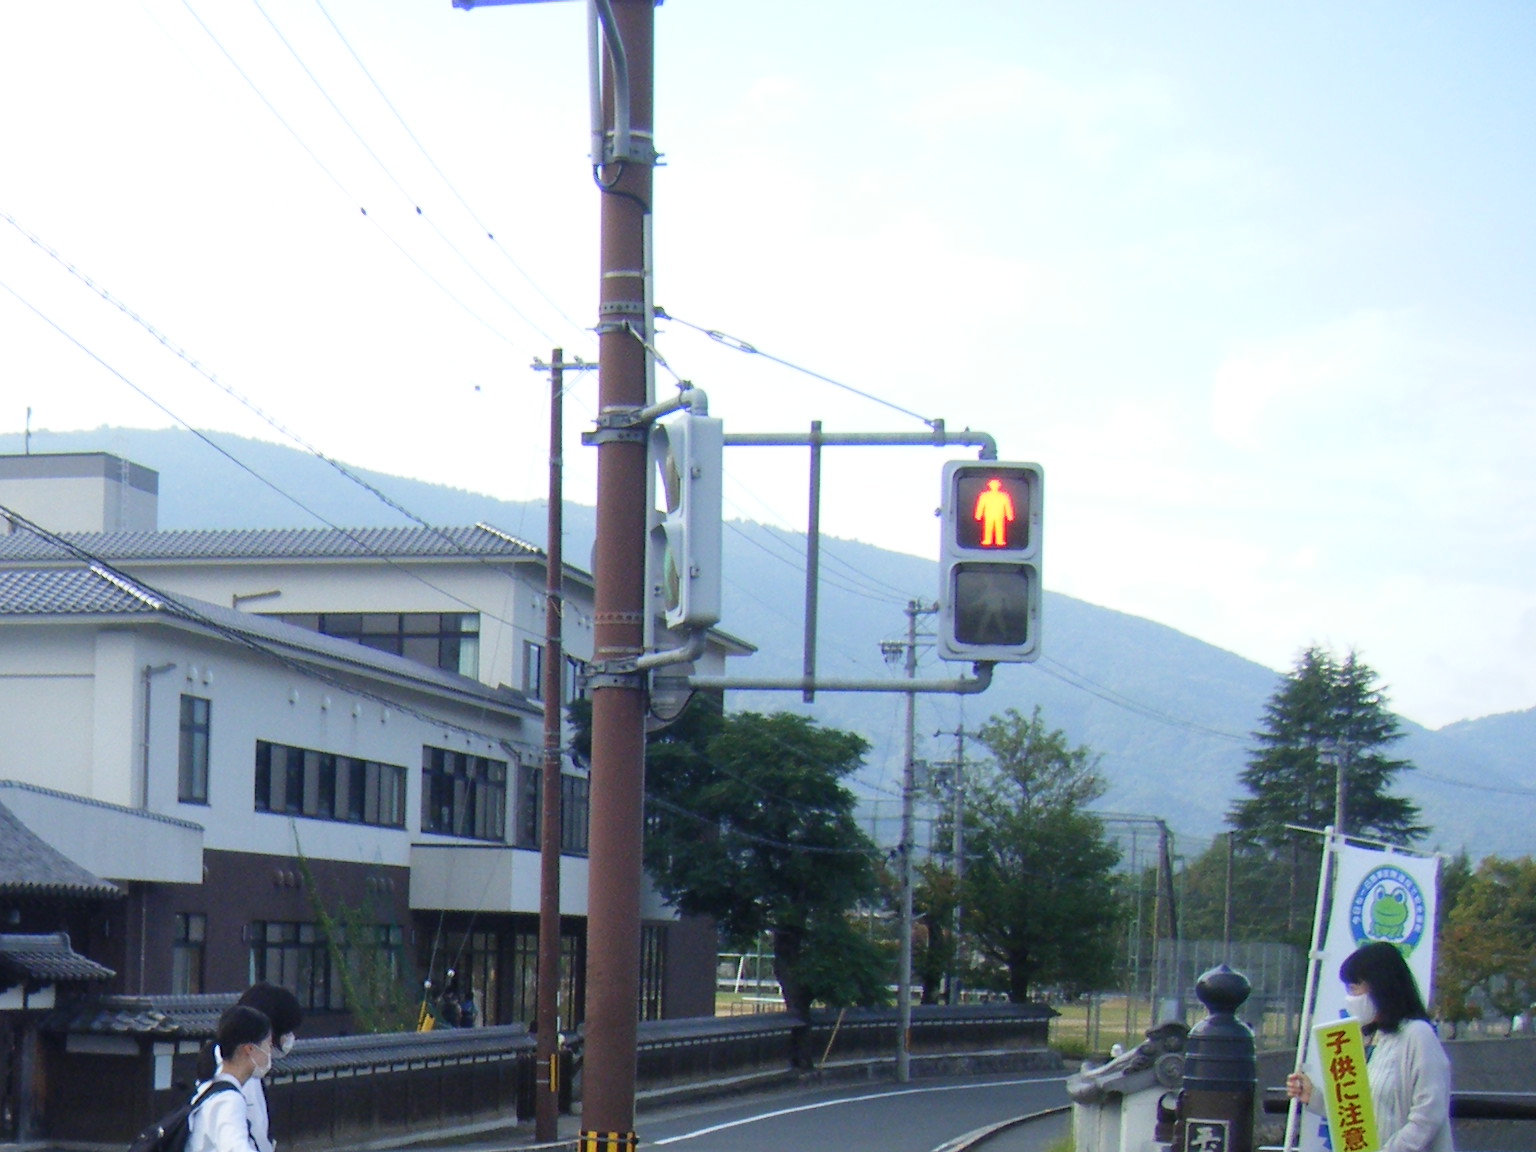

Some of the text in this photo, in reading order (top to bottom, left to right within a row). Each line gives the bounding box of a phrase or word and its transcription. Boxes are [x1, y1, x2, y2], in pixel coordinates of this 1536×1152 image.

[1326, 1030, 1369, 1152] 子供に注意
